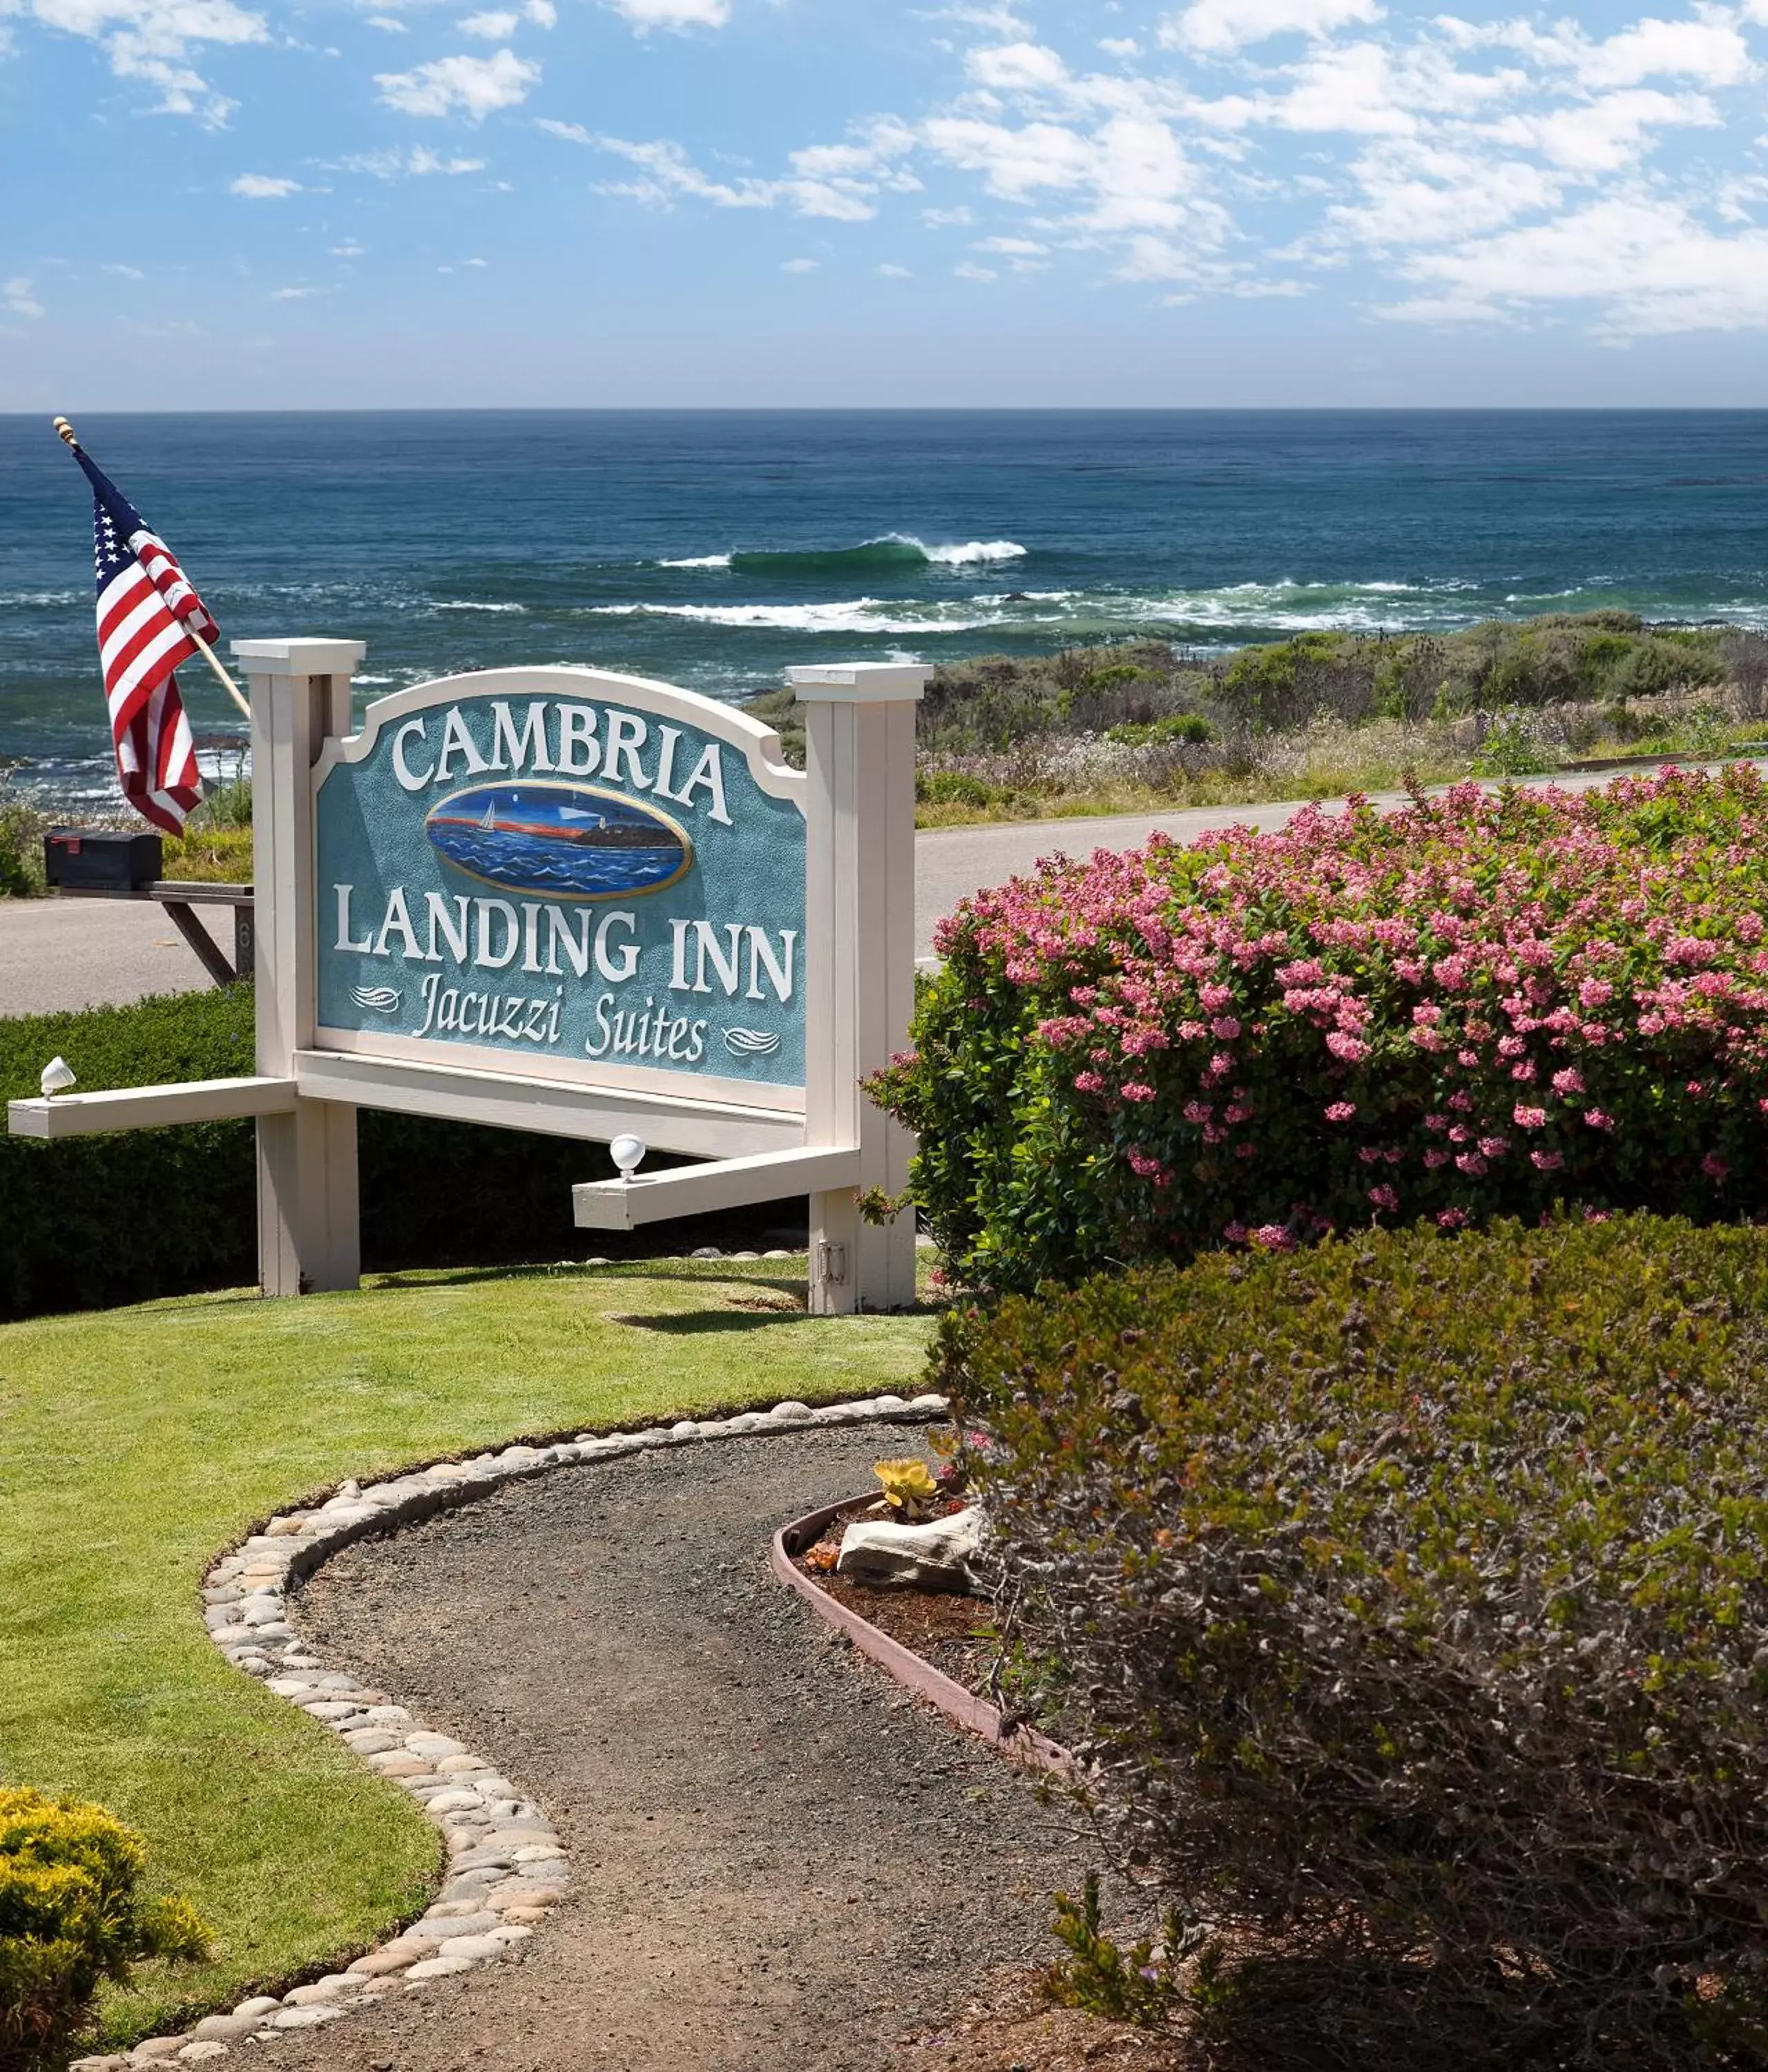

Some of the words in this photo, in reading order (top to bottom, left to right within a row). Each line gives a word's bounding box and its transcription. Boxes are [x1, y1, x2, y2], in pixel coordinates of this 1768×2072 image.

[392, 701, 734, 826] CAMBRIA
[332, 884, 642, 983] LANDING
[667, 918, 799, 1004] INN
[412, 973, 563, 1043] Jacuzzi
[586, 991, 707, 1062] Suites
